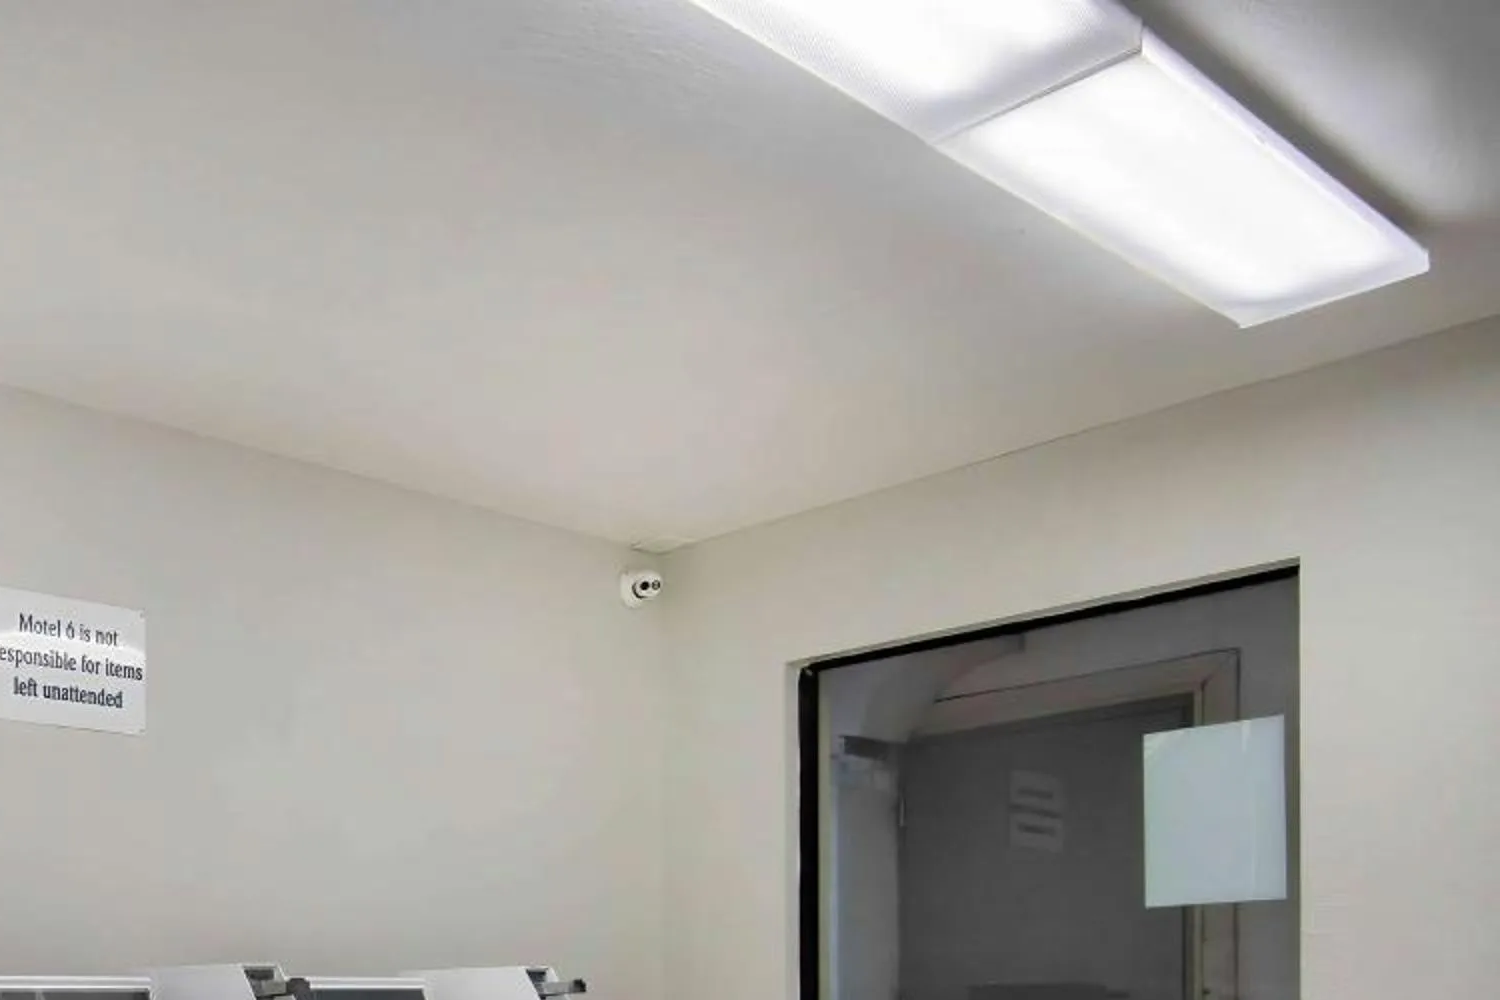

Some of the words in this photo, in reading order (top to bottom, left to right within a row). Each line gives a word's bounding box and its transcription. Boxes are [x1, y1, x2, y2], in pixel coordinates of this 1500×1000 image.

[19, 612, 61, 638] Motel
[65, 621, 75, 640] 6
[79, 624, 91, 643] is
[95, 629, 119, 647] not
[81, 655, 101, 675] for
[105, 658, 143, 681] items
[13, 676, 38, 698] left
[43, 684, 123, 709] unattended
